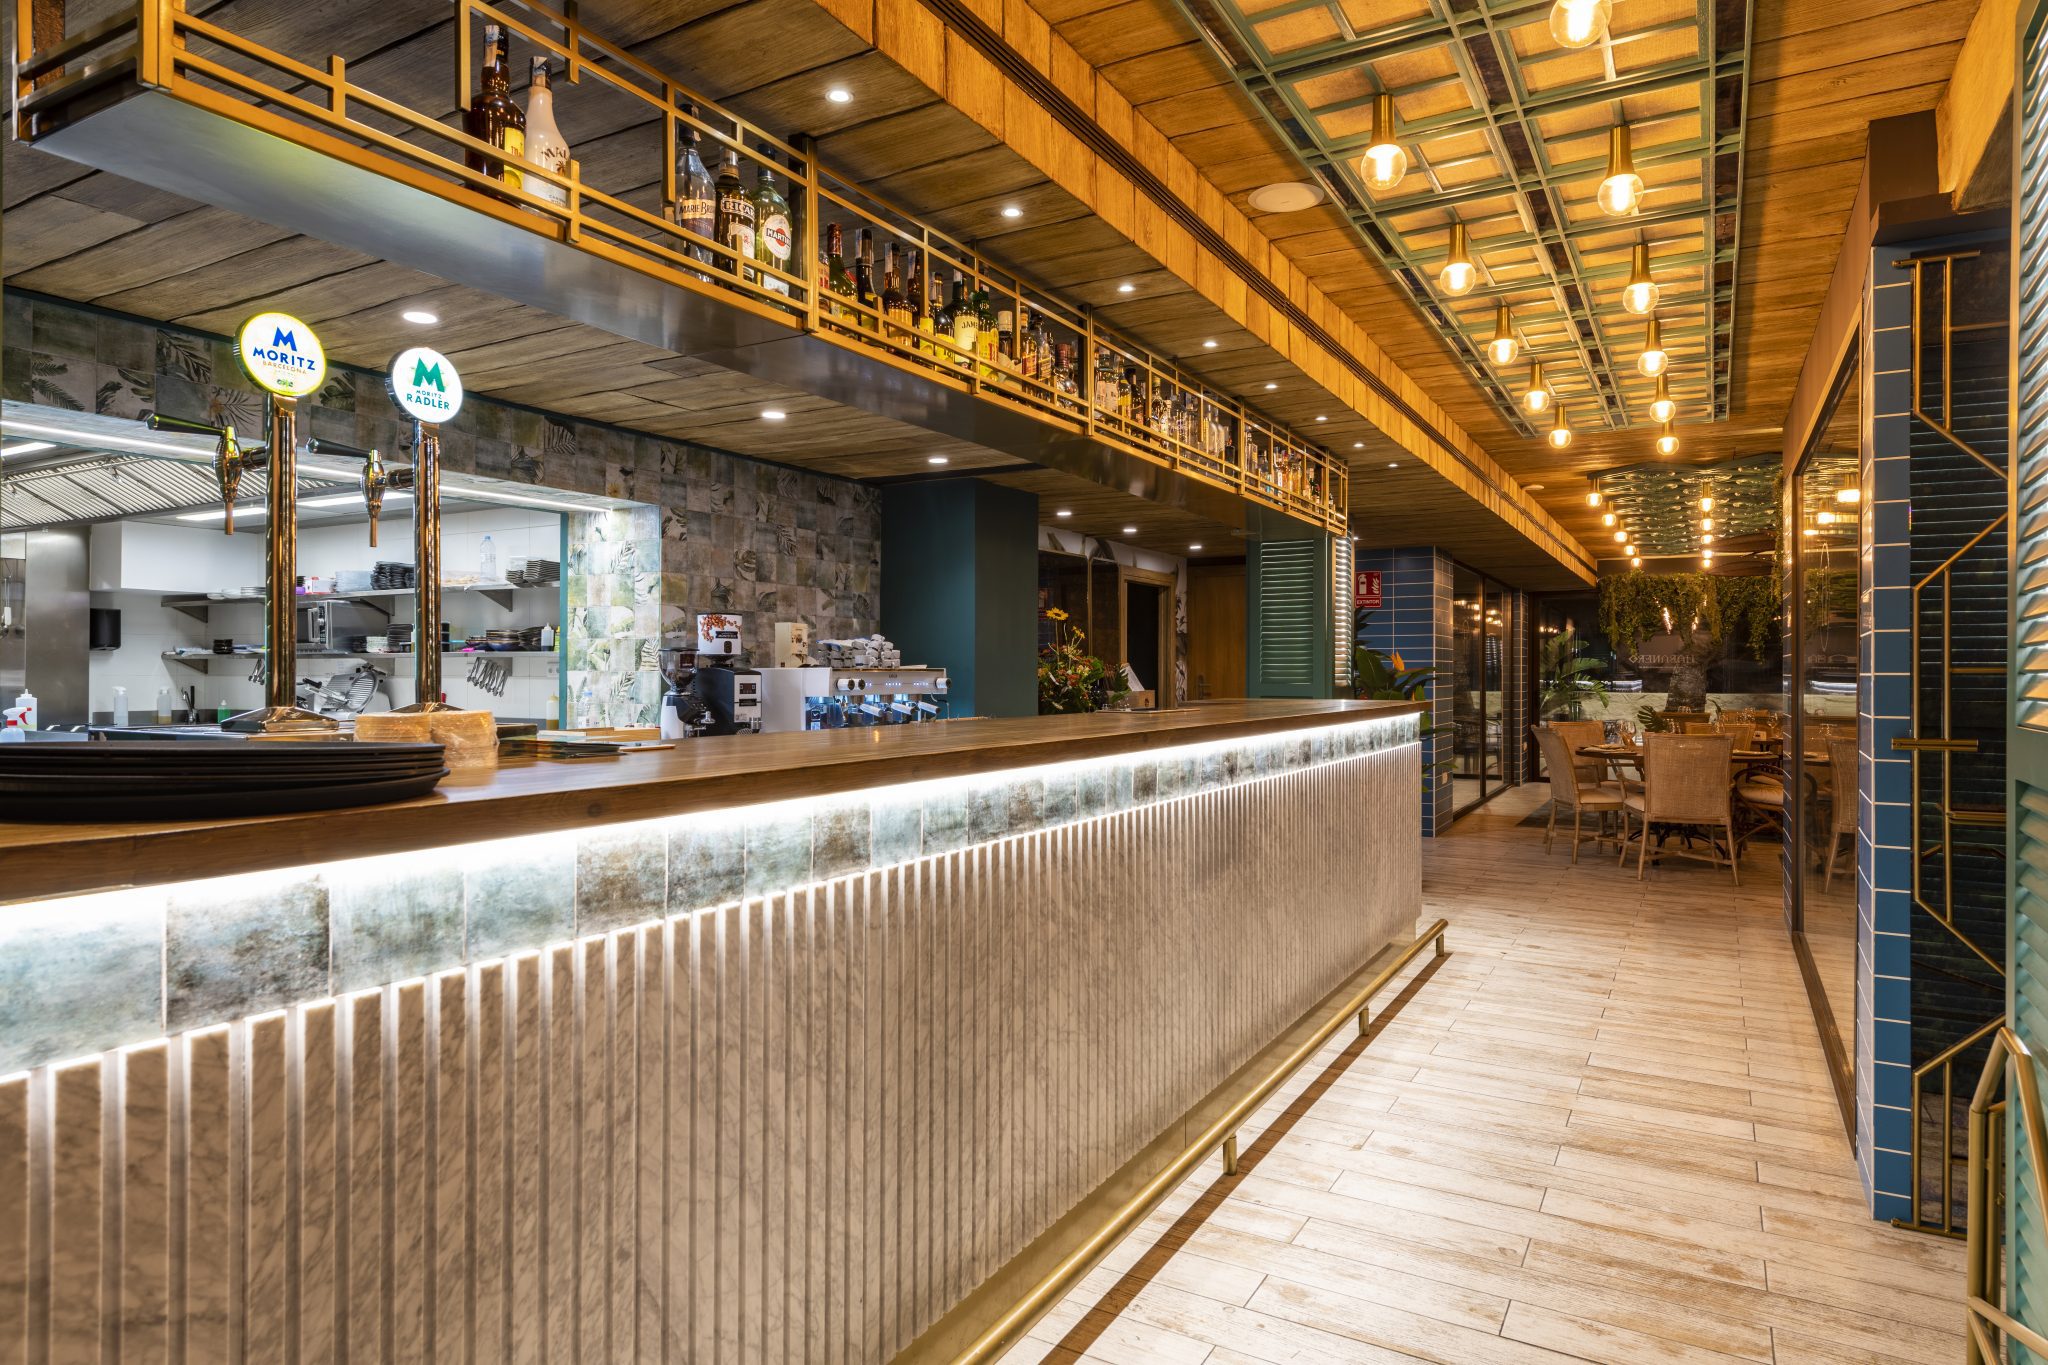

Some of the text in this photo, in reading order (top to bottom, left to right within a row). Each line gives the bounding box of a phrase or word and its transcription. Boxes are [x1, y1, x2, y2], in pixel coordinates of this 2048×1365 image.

[679, 204, 700, 214] MARIE
[272, 326, 297, 352] M
[253, 347, 315, 371] MORITZ
[262, 360, 307, 375] BARCELONA
[412, 357, 445, 392] M
[406, 393, 450, 410] RADLER
[416, 389, 442, 399] MORITZ
